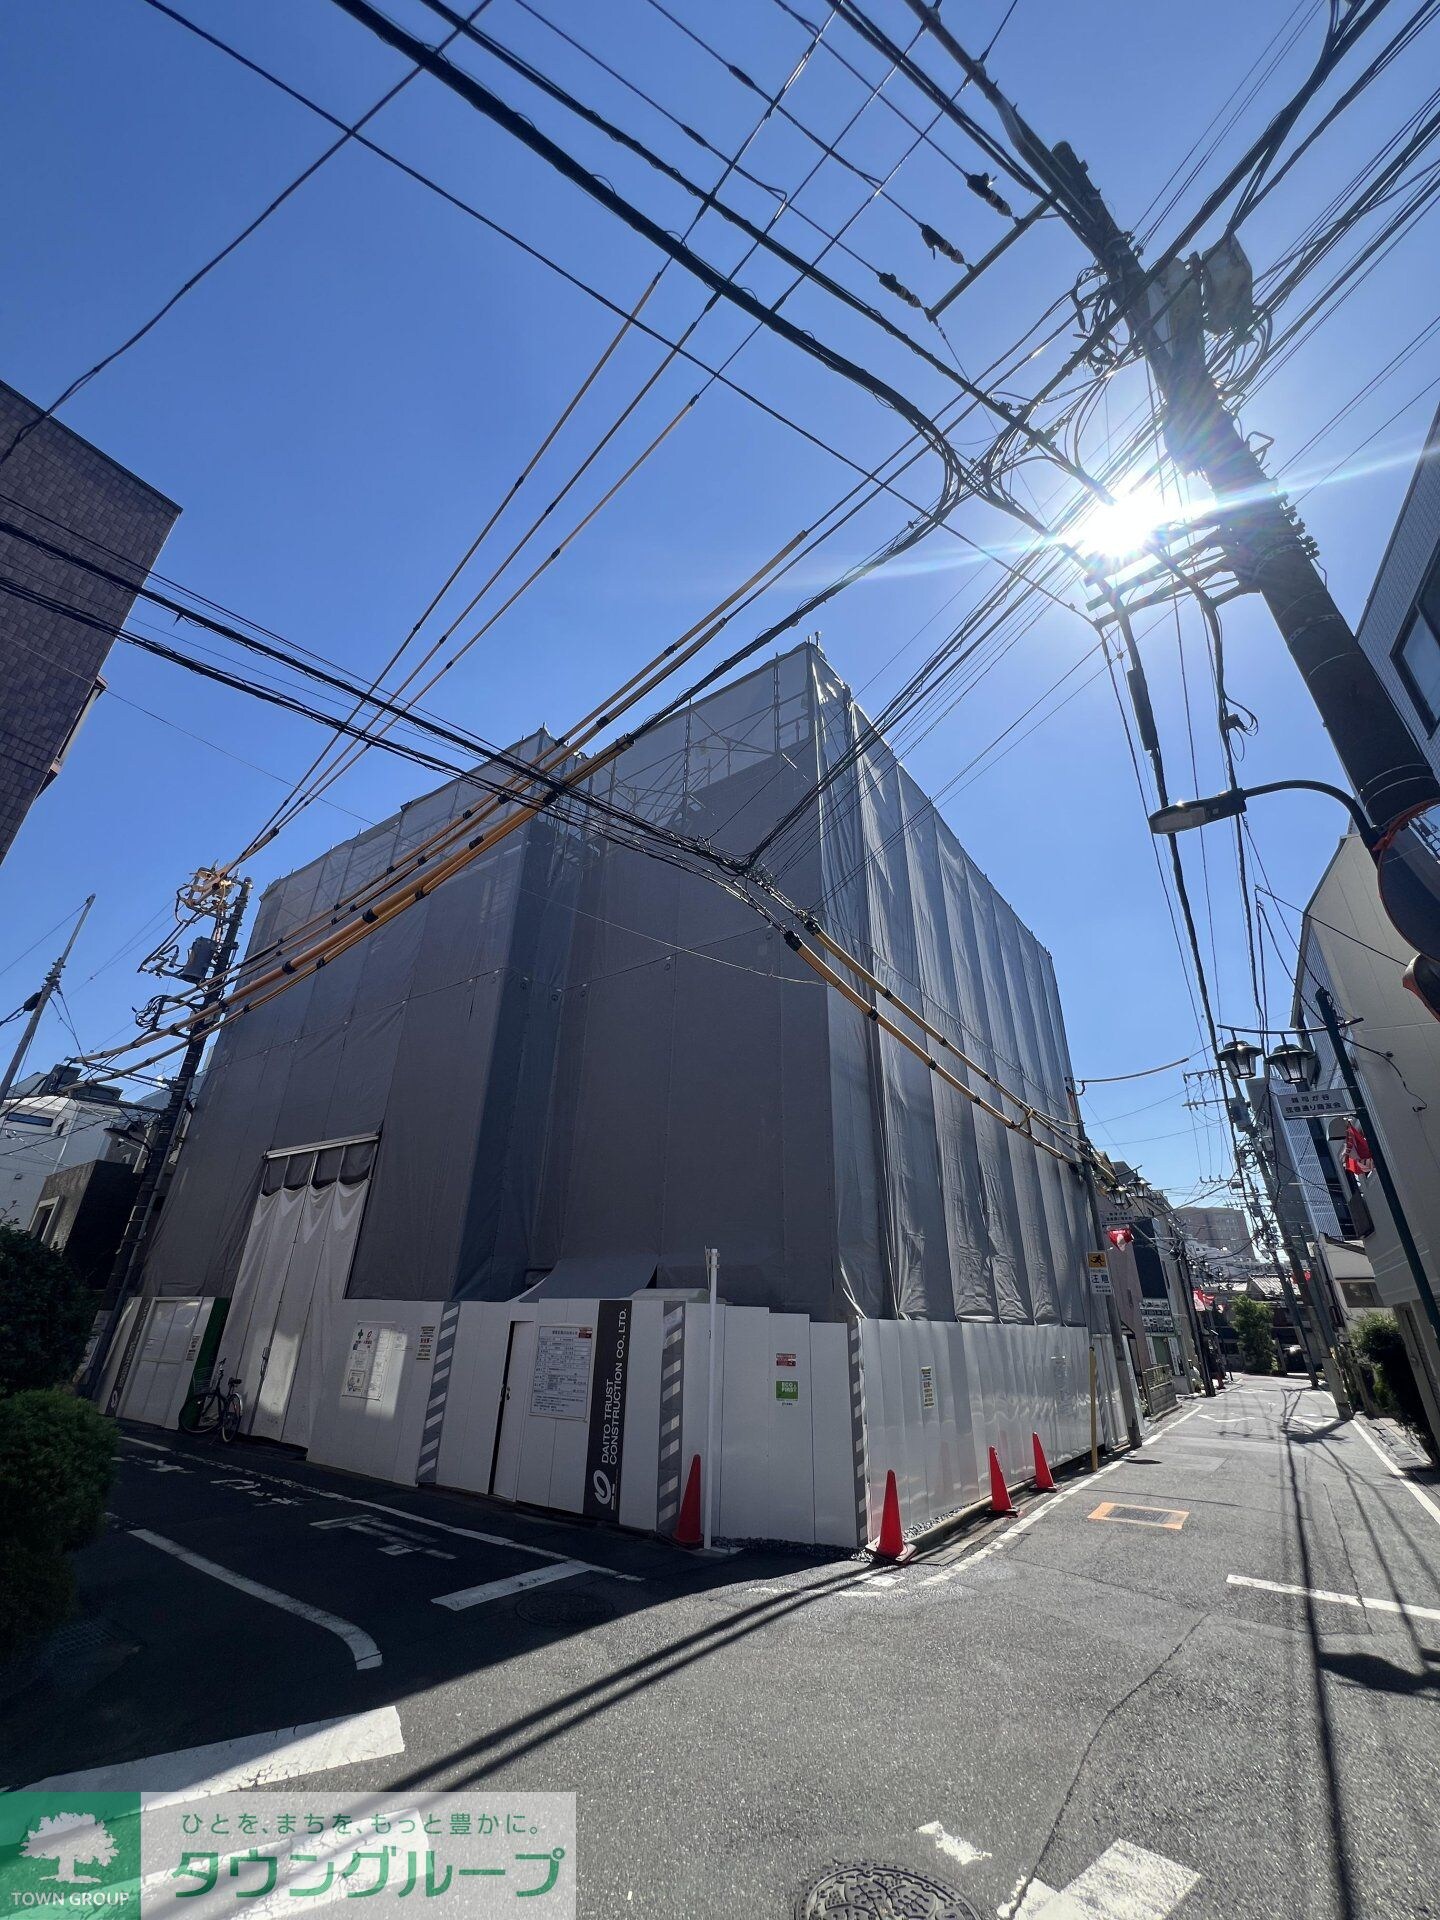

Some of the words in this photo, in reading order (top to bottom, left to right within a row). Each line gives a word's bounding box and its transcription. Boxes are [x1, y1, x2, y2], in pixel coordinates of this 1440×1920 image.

[604, 1378, 614, 1421] TRUST
[609, 1362, 623, 1465] CONSTRUCTION
[618, 1308, 627, 1332] LTD.
[601, 1424, 611, 1464] DAITO
